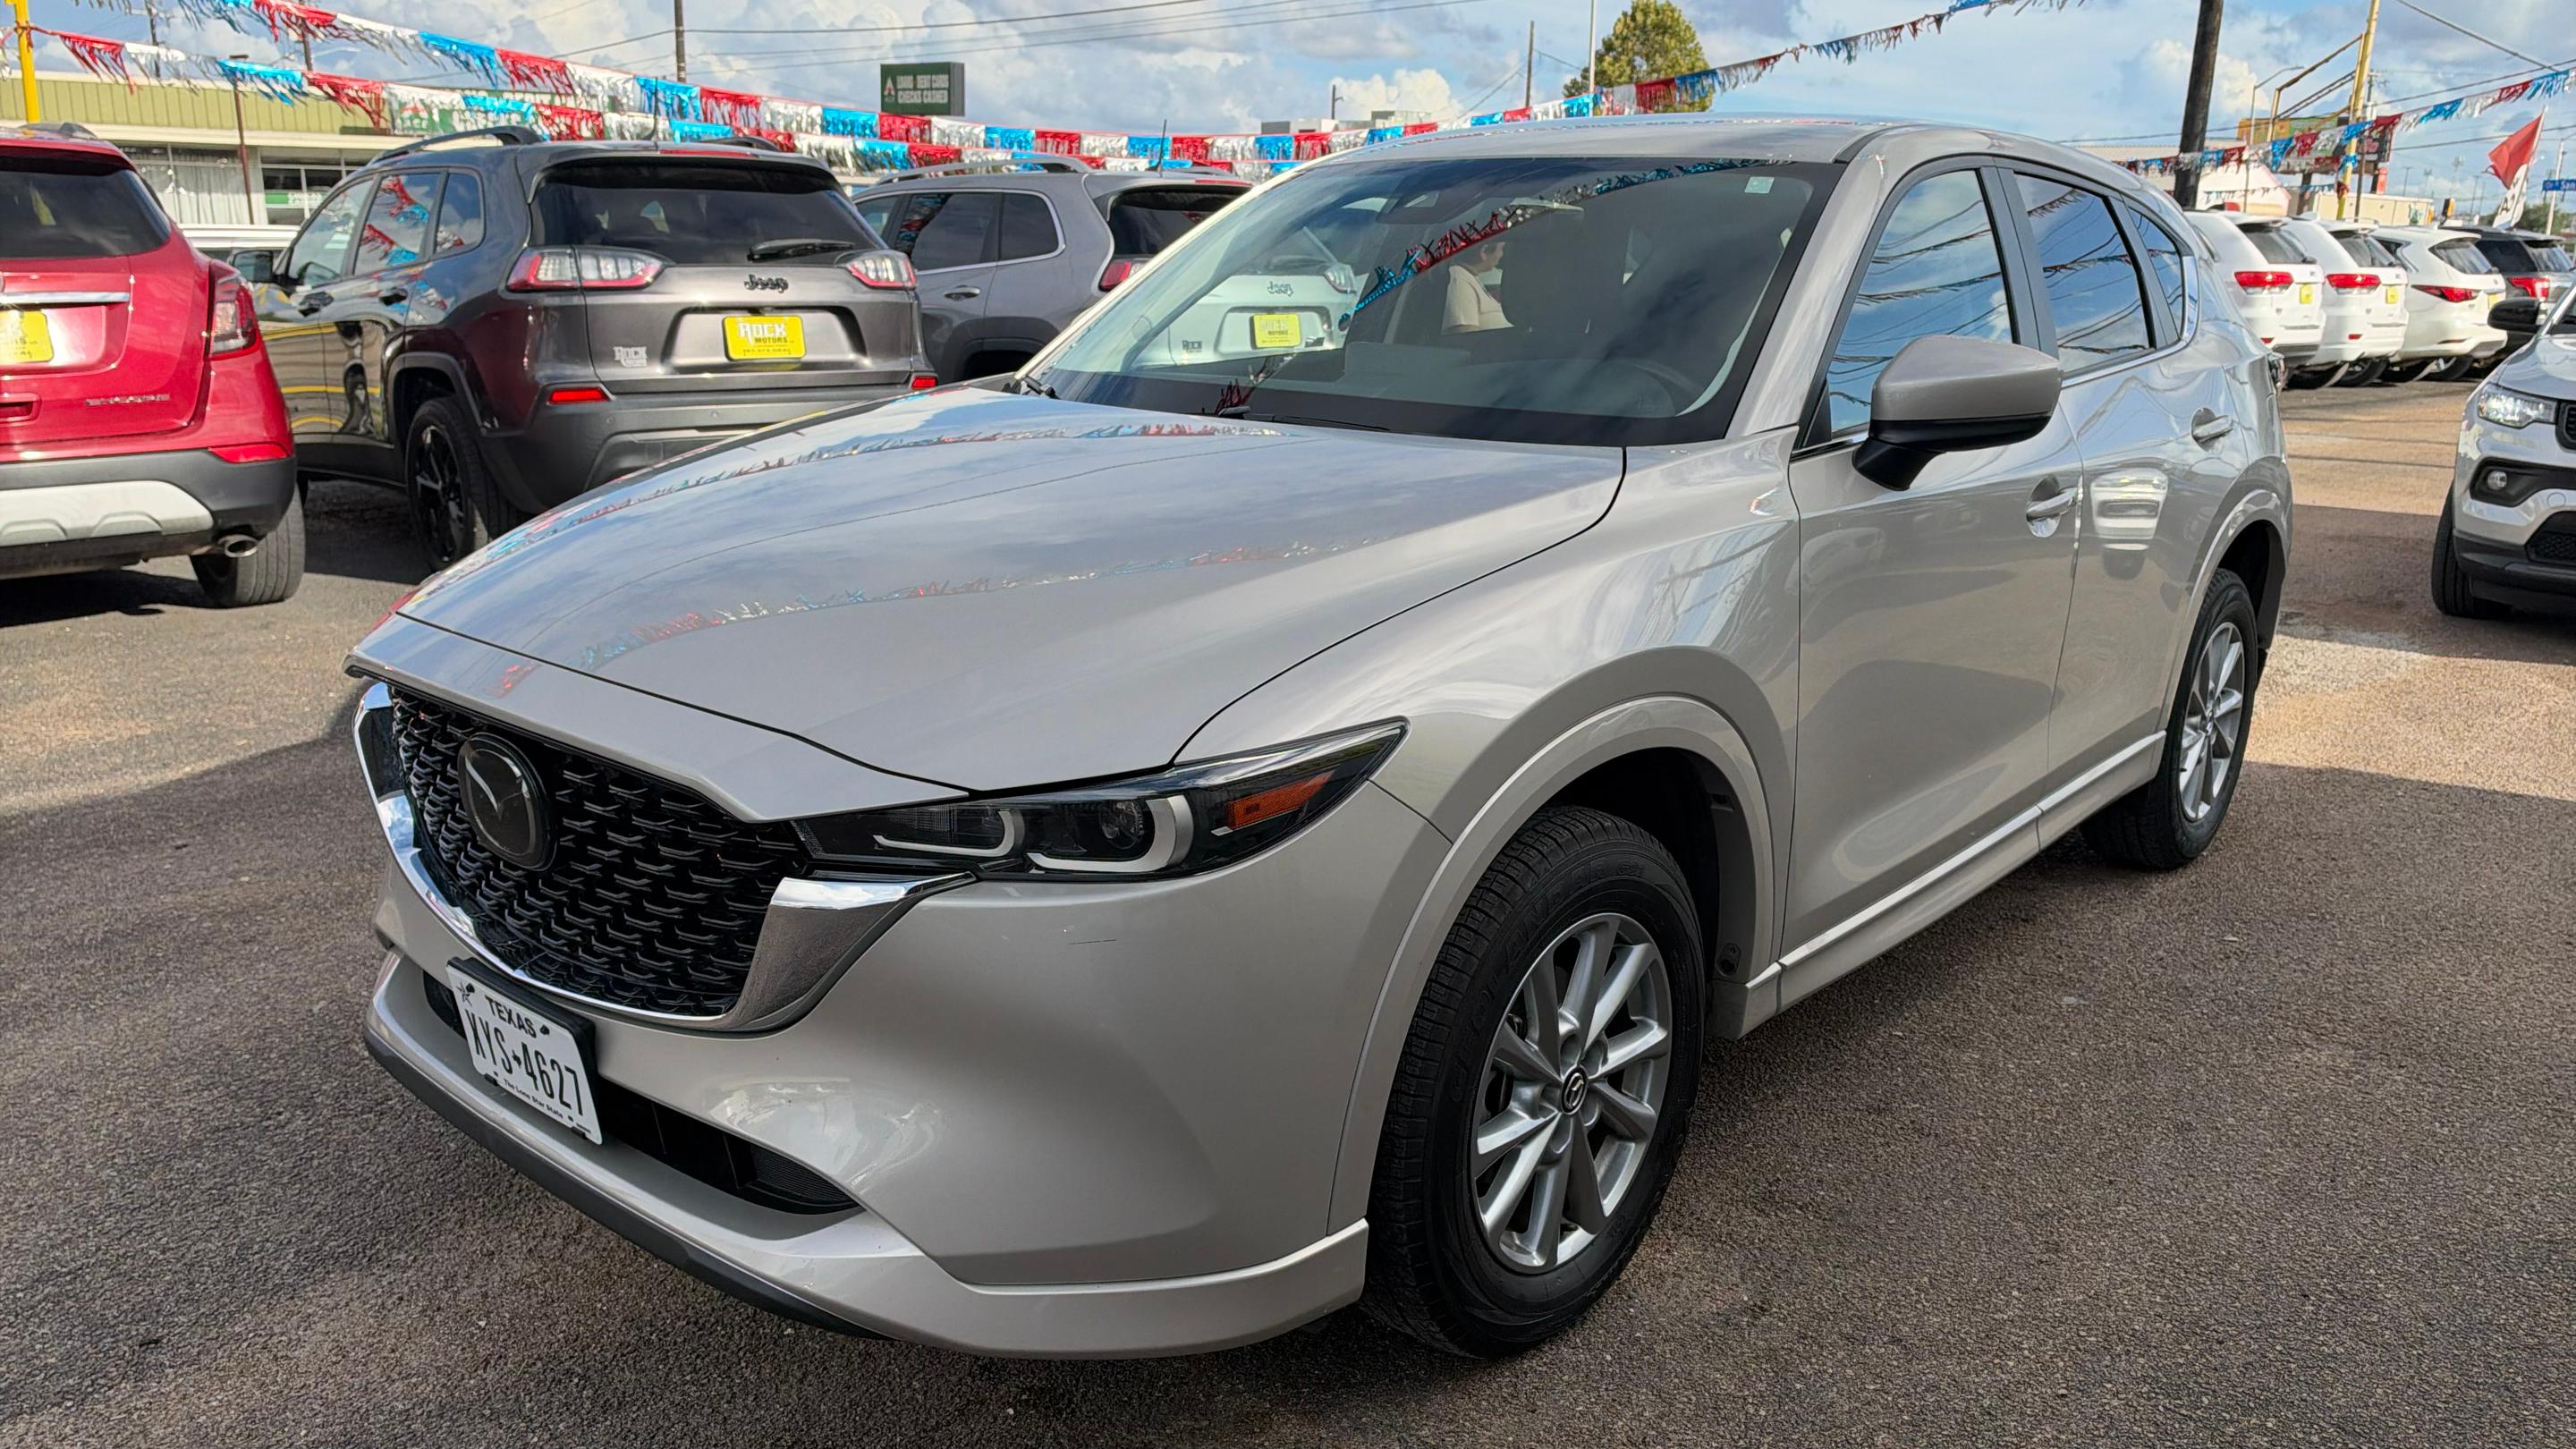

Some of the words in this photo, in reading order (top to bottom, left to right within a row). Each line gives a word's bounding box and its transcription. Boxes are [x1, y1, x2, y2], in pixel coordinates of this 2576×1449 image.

[744, 275, 789, 293] Jeep
[737, 323, 787, 345] ROCK
[613, 346, 648, 367] ROCK
[485, 995, 537, 1038] TEXAS
[504, 1078, 515, 1089] The
[532, 1096, 545, 1107] Star
[547, 1105, 564, 1119] State
